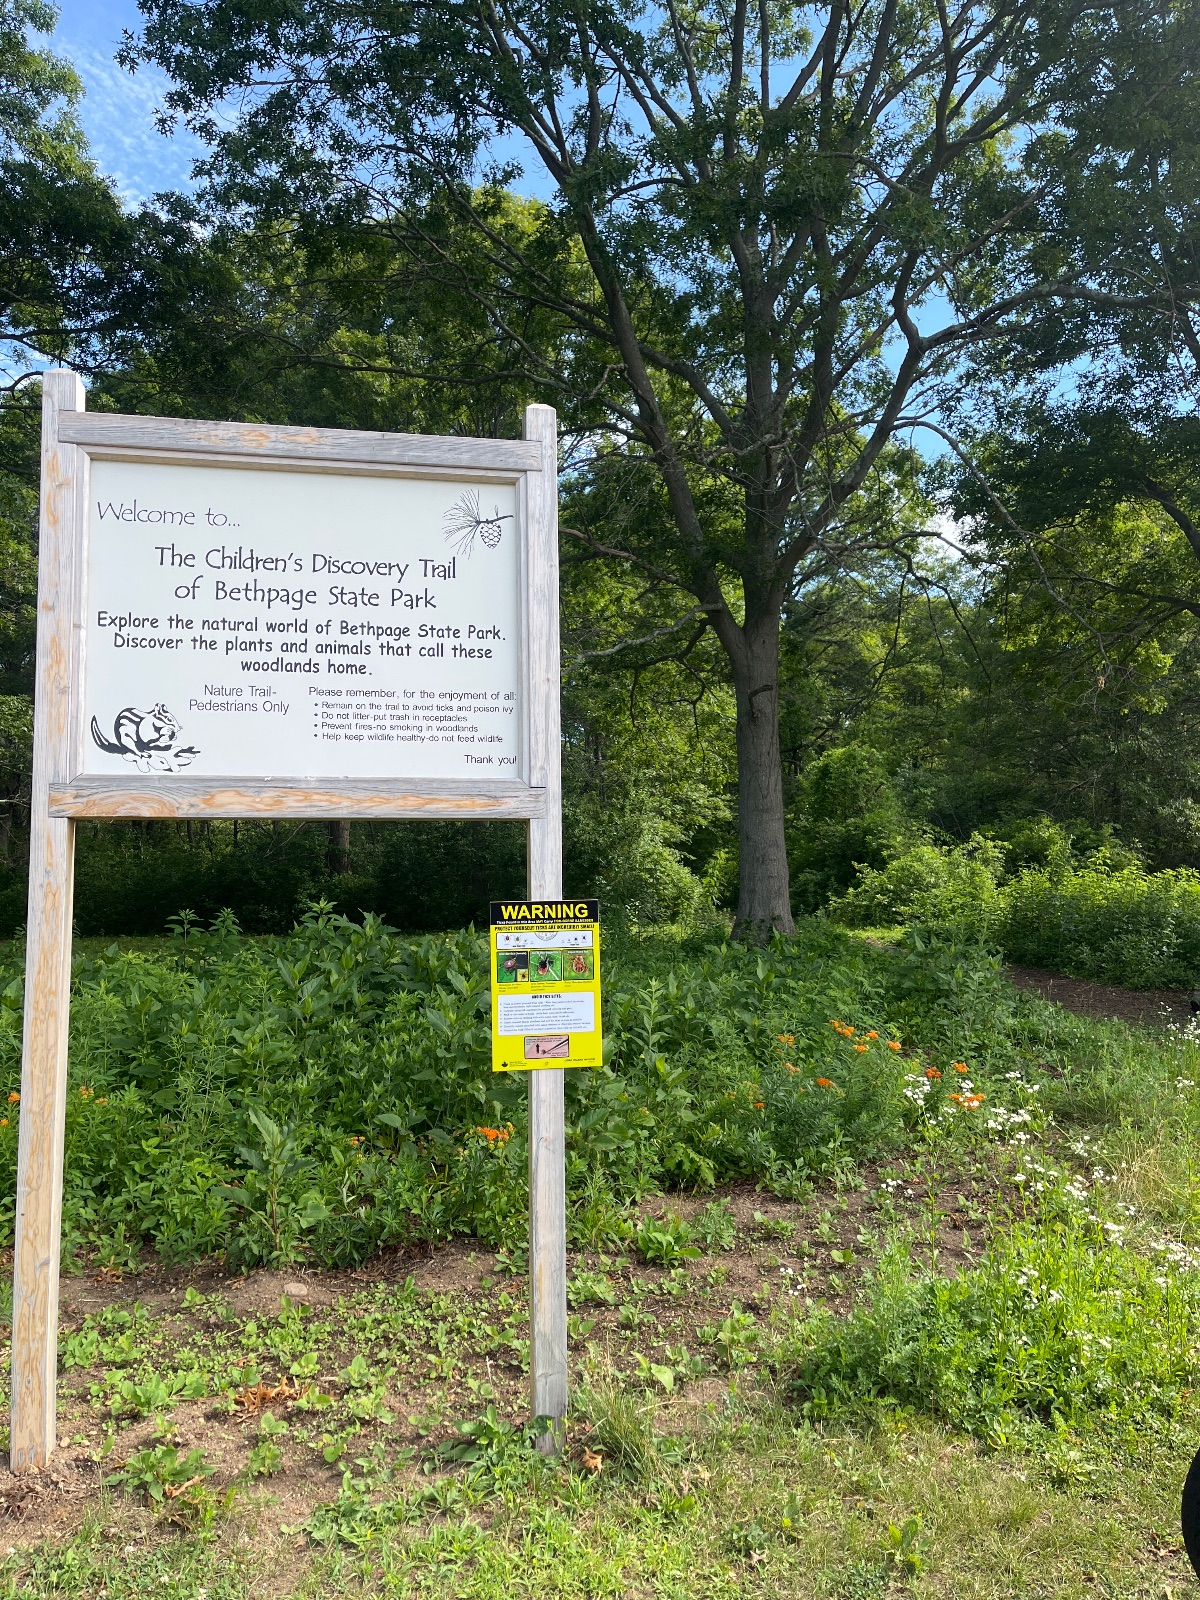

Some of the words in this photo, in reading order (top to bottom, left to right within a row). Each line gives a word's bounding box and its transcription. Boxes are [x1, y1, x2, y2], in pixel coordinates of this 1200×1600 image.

[97, 499, 195, 525] Welcome
[205, 508, 240, 527] to...
[155, 543, 195, 567] The
[205, 546, 303, 572] Children's
[312, 554, 409, 583] Discovery
[419, 556, 456, 580] Trail
[174, 575, 203, 599] of
[215, 579, 317, 610] Bethpage
[329, 586, 379, 607] State
[391, 588, 436, 609] Park
[97, 611, 159, 631] Explore
[167, 614, 194, 629] the
[202, 617, 258, 632] natural
[266, 619, 308, 634] world
[315, 620, 332, 635] of
[340, 620, 410, 641] Bethpage
[418, 624, 461, 639] State
[468, 625, 506, 641] Park.
[114, 632, 183, 649] Discover
[191, 635, 218, 650] the
[226, 636, 273, 655] plants
[280, 639, 308, 653] and
[315, 640, 371, 655] animals
[379, 642, 412, 656] that
[418, 643, 444, 657] call
[451, 643, 493, 659] these
[241, 657, 320, 673] woodlands
[327, 659, 373, 675] home.
[204, 684, 243, 697] Nature
[248, 686, 276, 697] Trail-
[309, 687, 342, 696] Please
[346, 689, 399, 699] remember,
[403, 689, 415, 698] for
[420, 690, 435, 699] the
[439, 690, 487, 701] enjoyment
[491, 692, 500, 700] of
[504, 692, 517, 700] all:
[189, 700, 258, 712] Pedestrians
[263, 701, 290, 715] Only
[322, 701, 352, 709] Remain
[436, 704, 453, 712] ticks
[474, 705, 499, 713] poison
[503, 705, 513, 714] ivy
[353, 712, 386, 721] litter-put
[422, 714, 467, 723] receptacles
[322, 722, 352, 730] Prevent
[389, 724, 422, 733] smoking
[323, 732, 341, 741] Help
[345, 733, 364, 742] keep
[367, 733, 394, 741] wildlife
[397, 734, 439, 743] healthy-do
[442, 734, 454, 742] not
[464, 755, 493, 764] Thank
[498, 756, 517, 766] you!
[501, 904, 589, 920] WARNING
